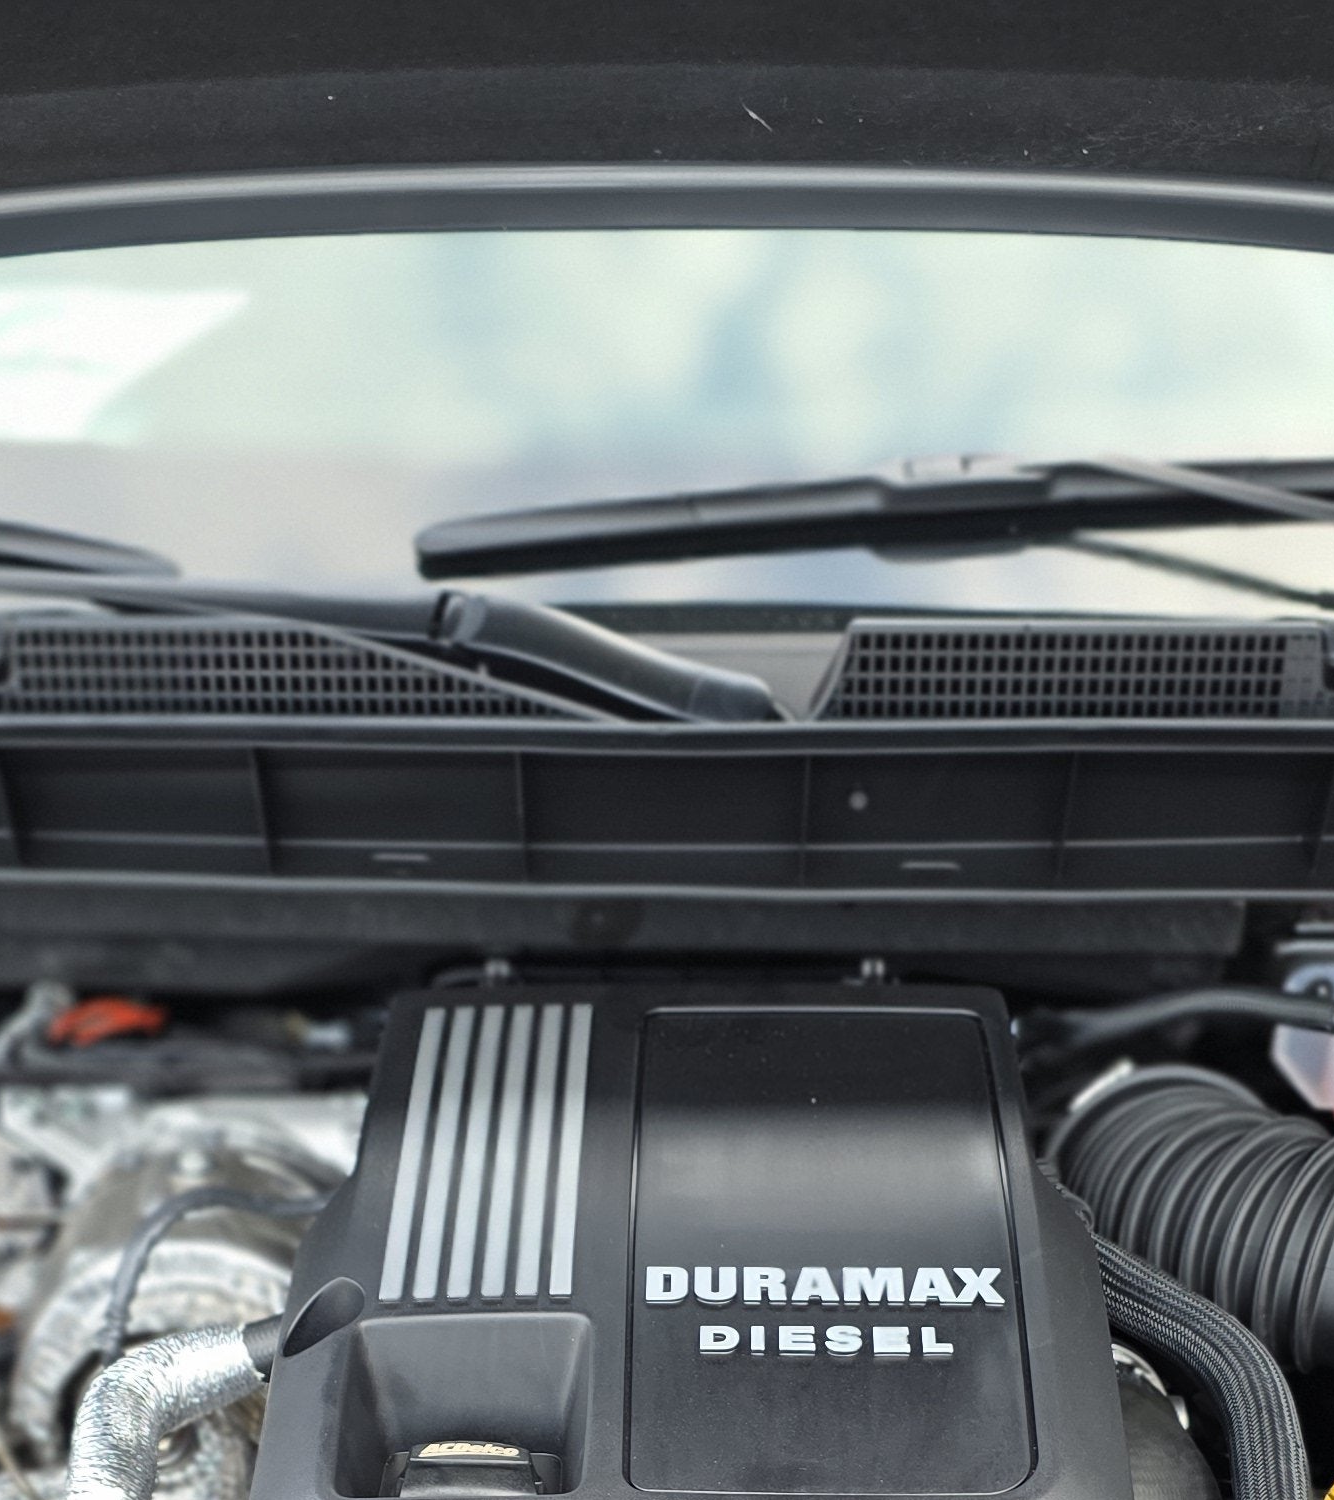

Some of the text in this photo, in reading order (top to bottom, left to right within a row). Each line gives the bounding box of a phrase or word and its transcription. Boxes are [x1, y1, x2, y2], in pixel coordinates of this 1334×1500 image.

[645, 1266, 1005, 1306] DURAMAX
[698, 1325, 954, 1356] DIESEL
[418, 1442, 520, 1457] ACDelco
